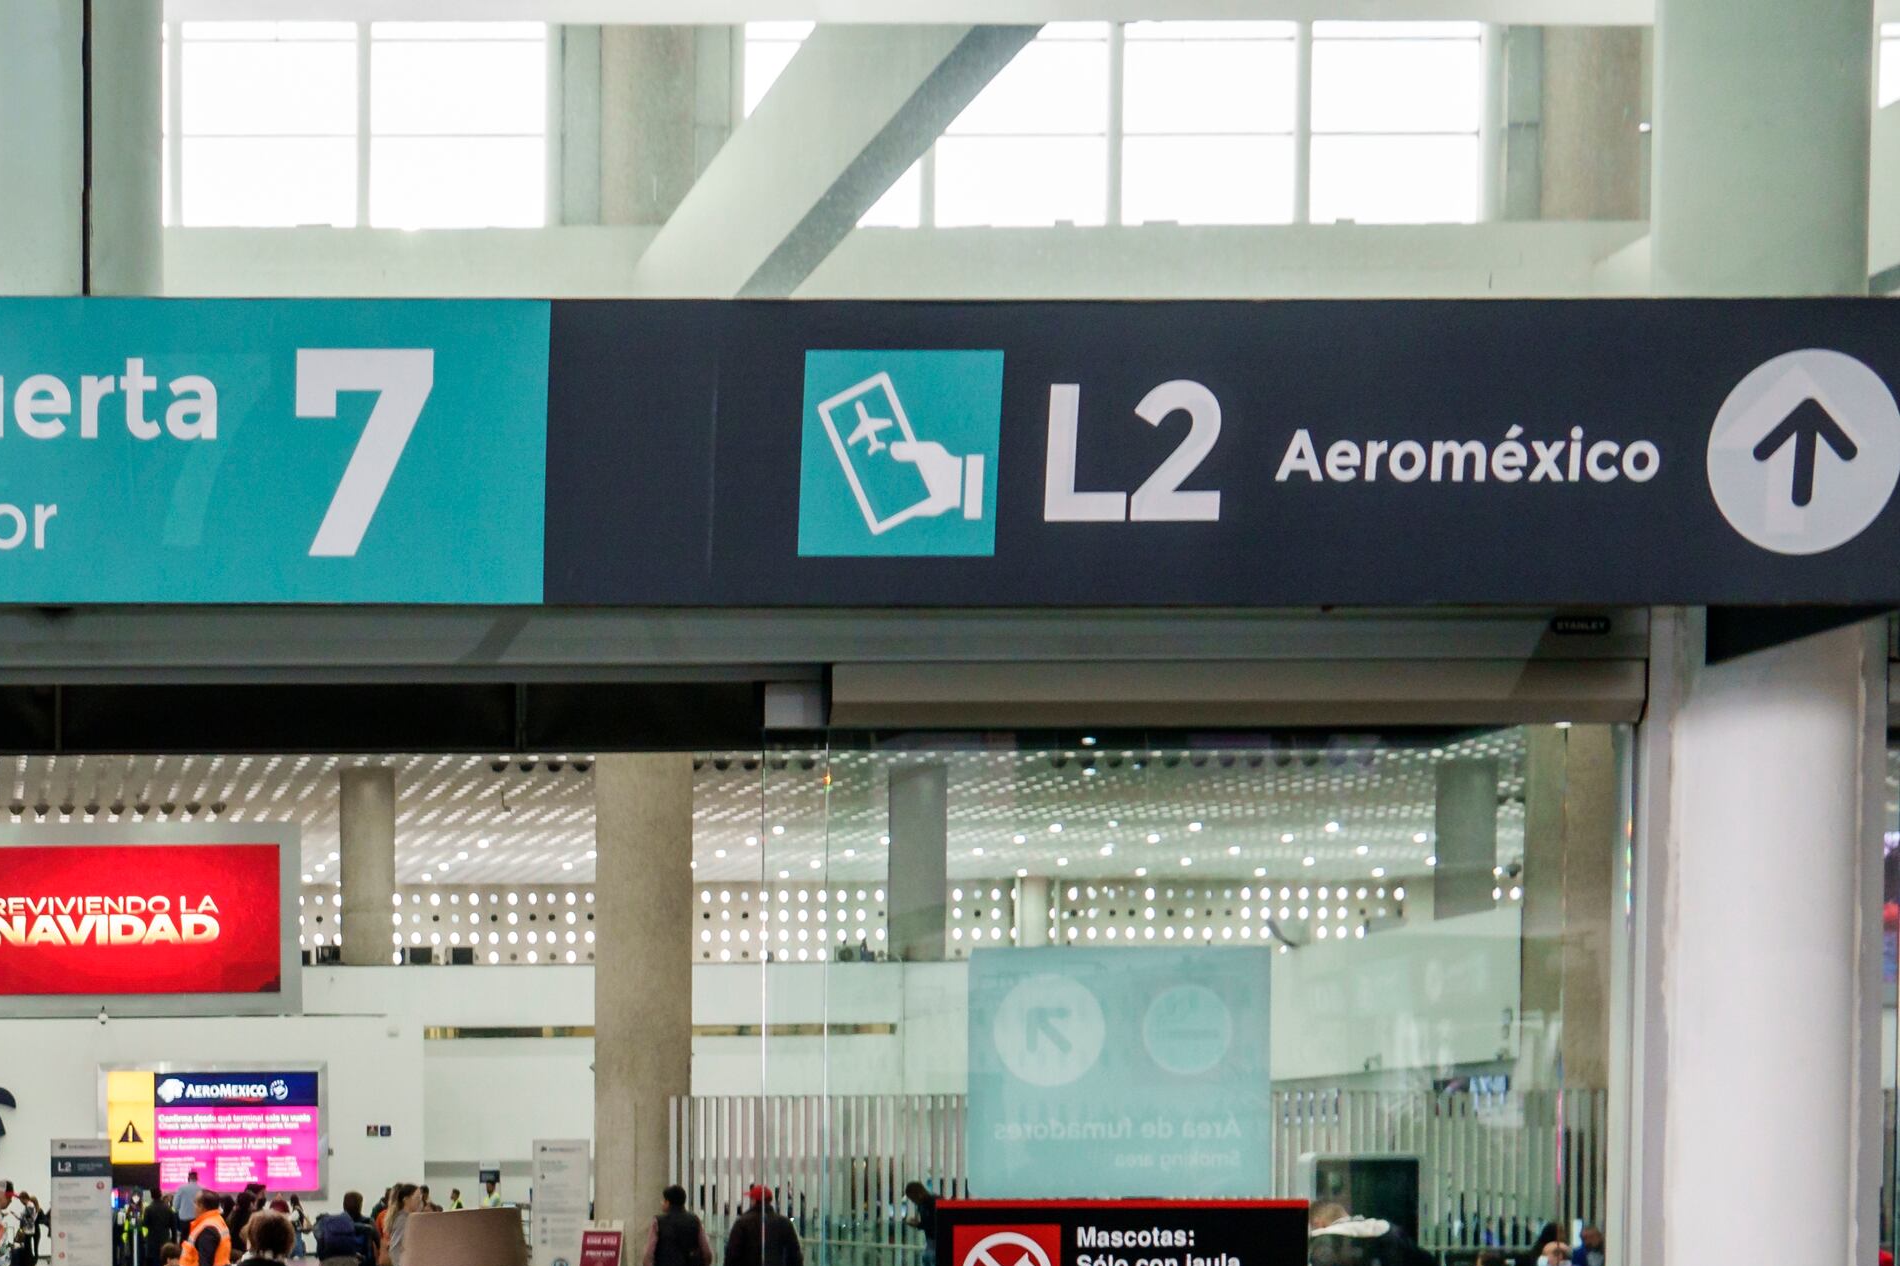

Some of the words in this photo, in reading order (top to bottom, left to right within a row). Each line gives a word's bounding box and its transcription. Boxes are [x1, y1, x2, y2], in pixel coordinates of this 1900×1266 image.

[294, 348, 435, 558] 7
[1043, 379, 1222, 522] L2
[1274, 424, 1660, 483] Aeroméxico
[179, 894, 220, 914] LA
[1076, 1226, 1195, 1248] Mascotas:
